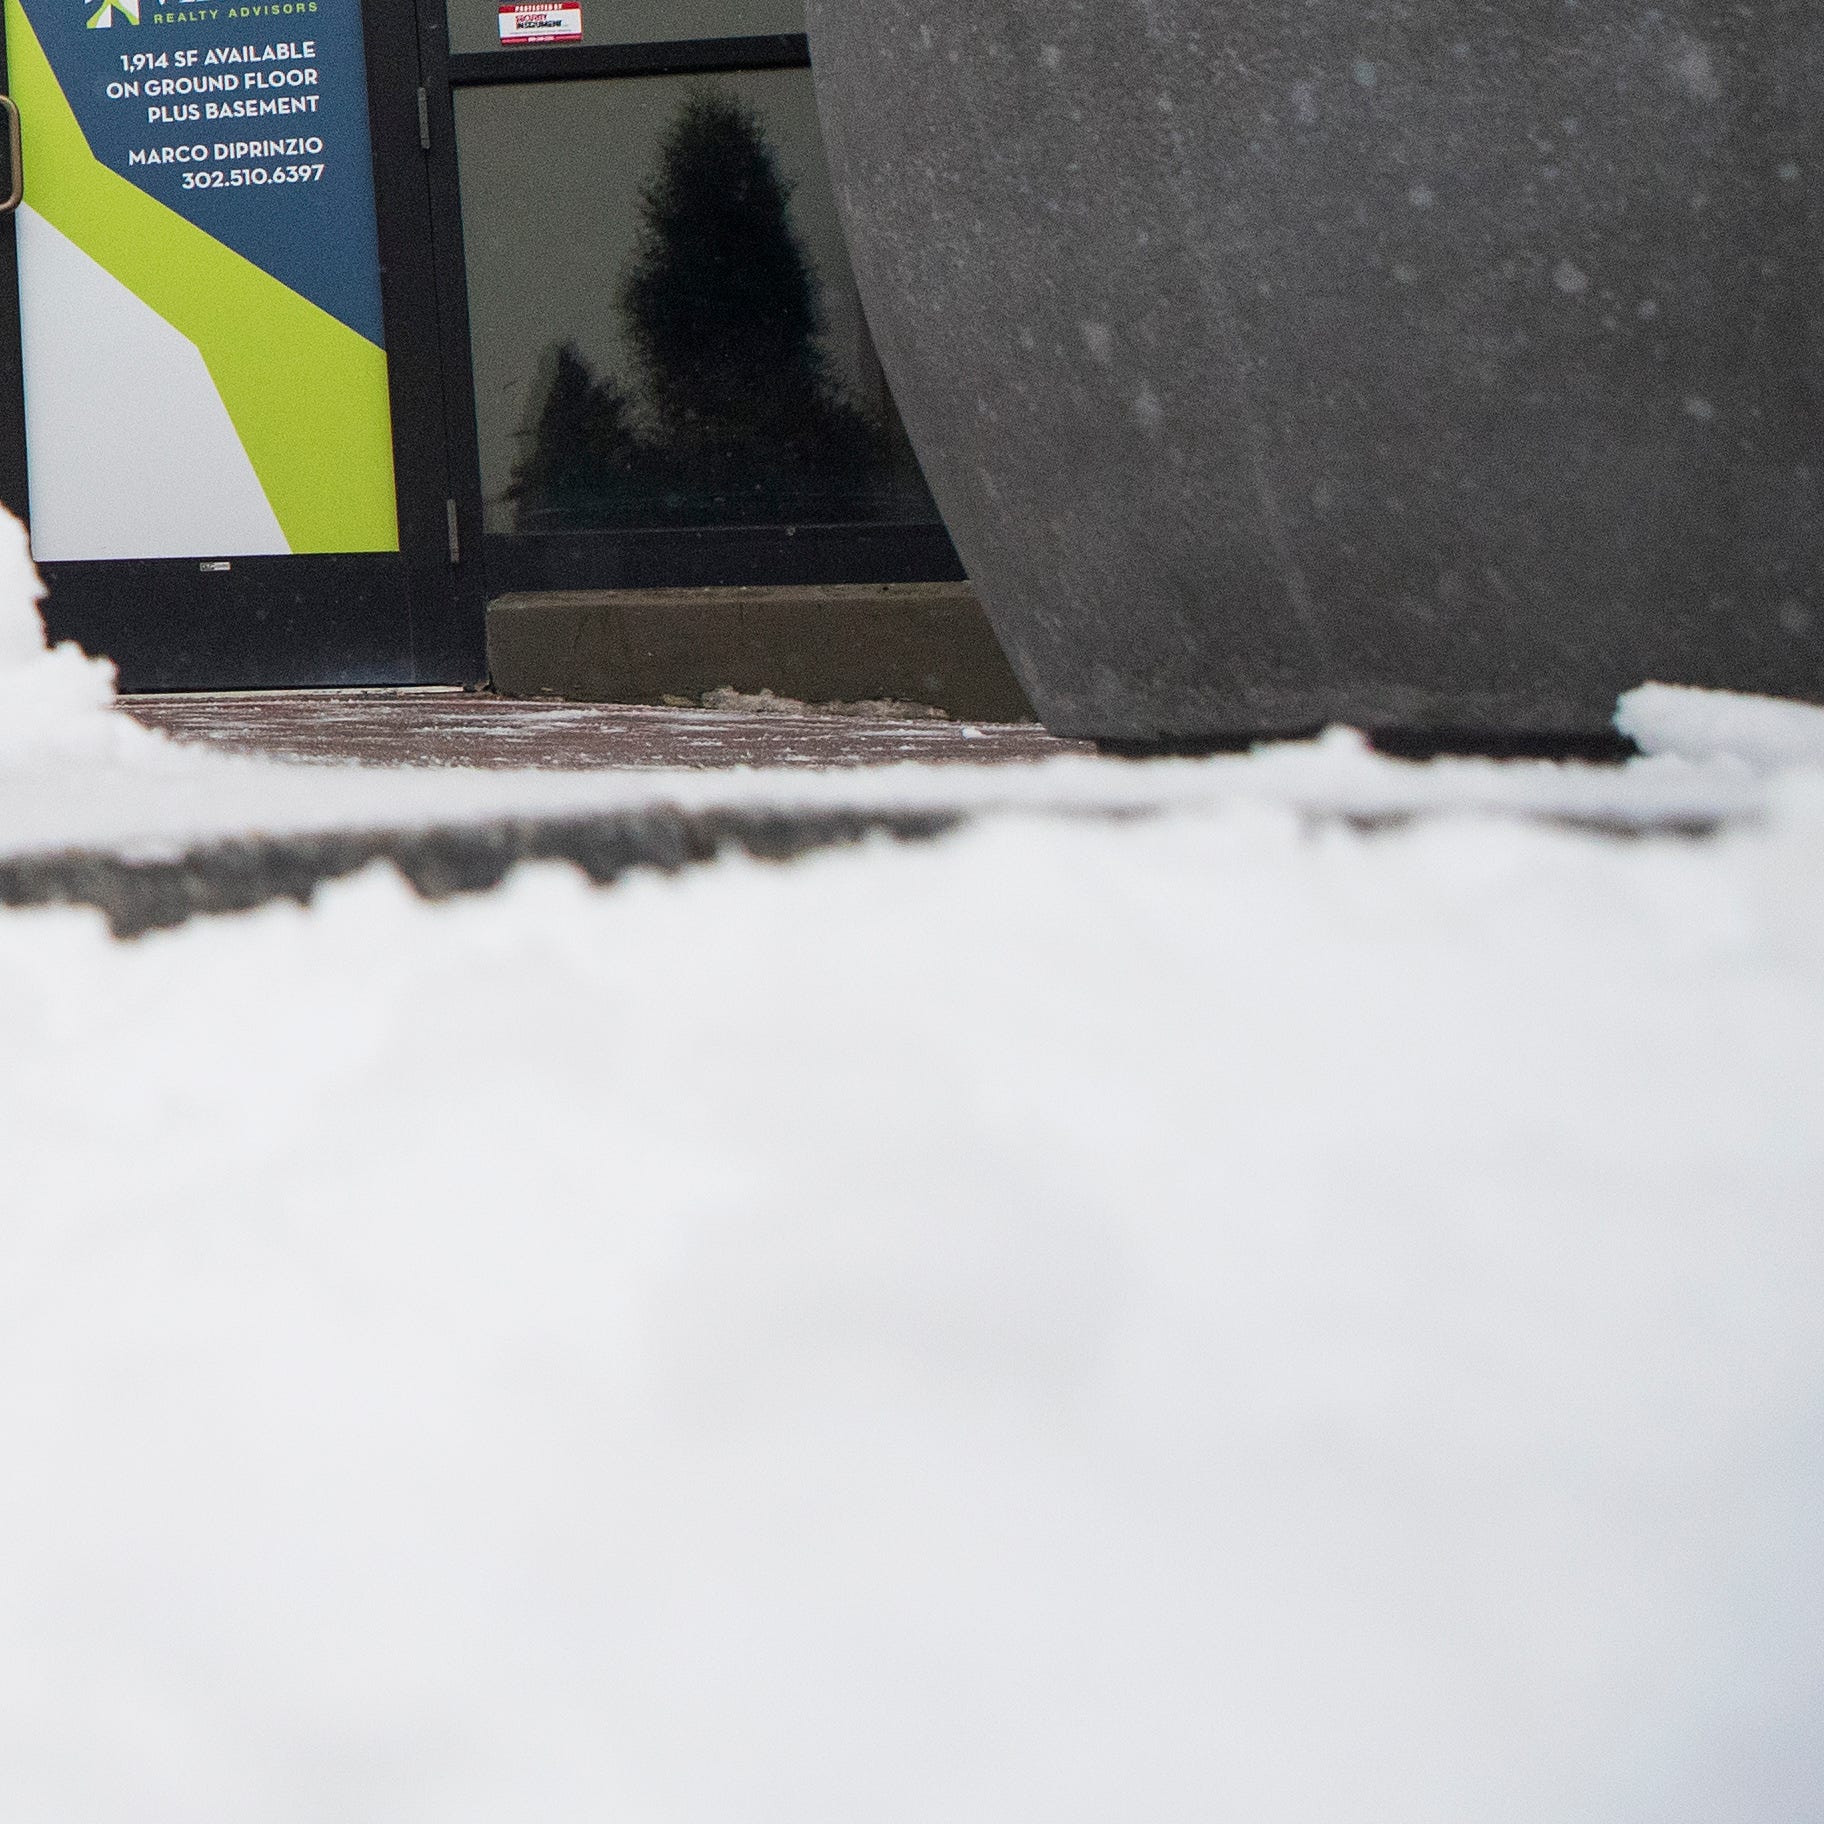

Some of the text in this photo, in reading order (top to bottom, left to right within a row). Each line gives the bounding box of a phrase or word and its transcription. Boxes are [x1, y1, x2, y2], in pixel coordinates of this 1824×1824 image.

[153, 2, 318, 24] REALTY ADVISORS
[120, 41, 316, 73] 1,914 SF AVAILABLE
[106, 69, 318, 99] ON GROUND FLOOR
[148, 95, 319, 123] PLUS BASEMENT
[129, 137, 323, 166] MARCO DIPRINZIO
[182, 164, 324, 189] 302.510.6397
